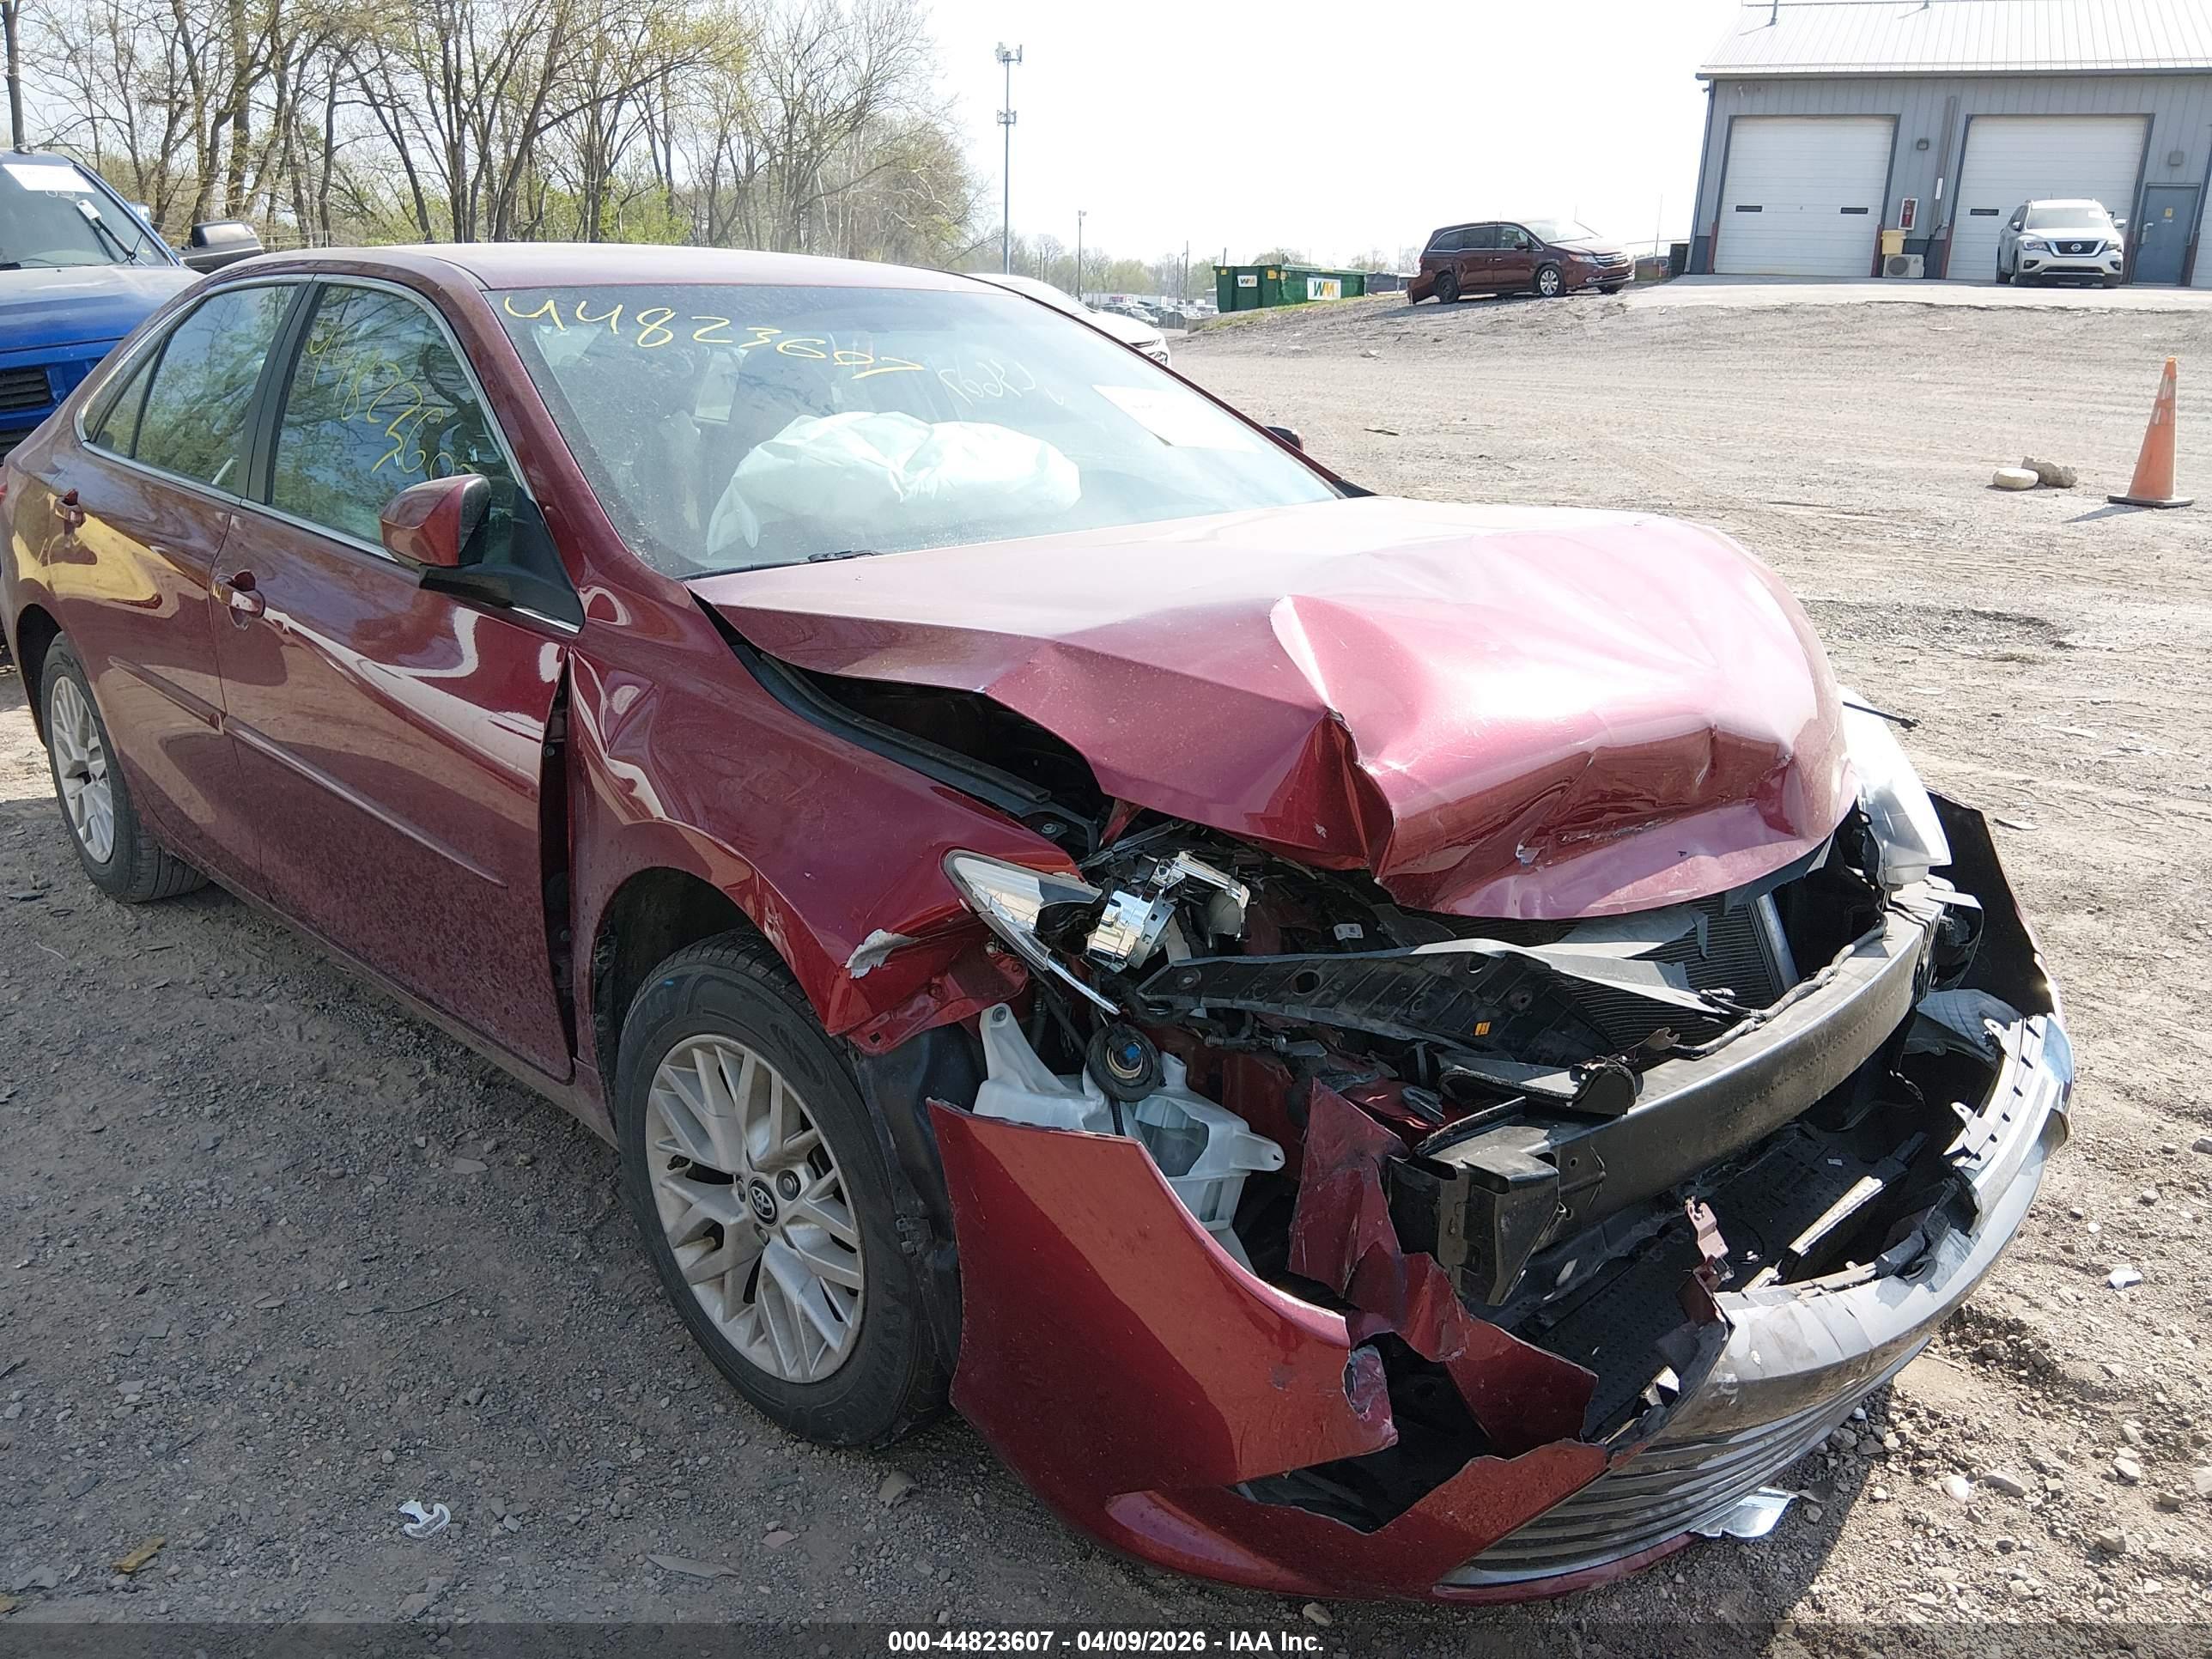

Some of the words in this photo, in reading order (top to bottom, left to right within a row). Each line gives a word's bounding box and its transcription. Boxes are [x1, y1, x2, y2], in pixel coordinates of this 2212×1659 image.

[1314, 281, 1336, 296] WM
[503, 295, 926, 380] 44823607
[308, 316, 477, 480] 4482360
